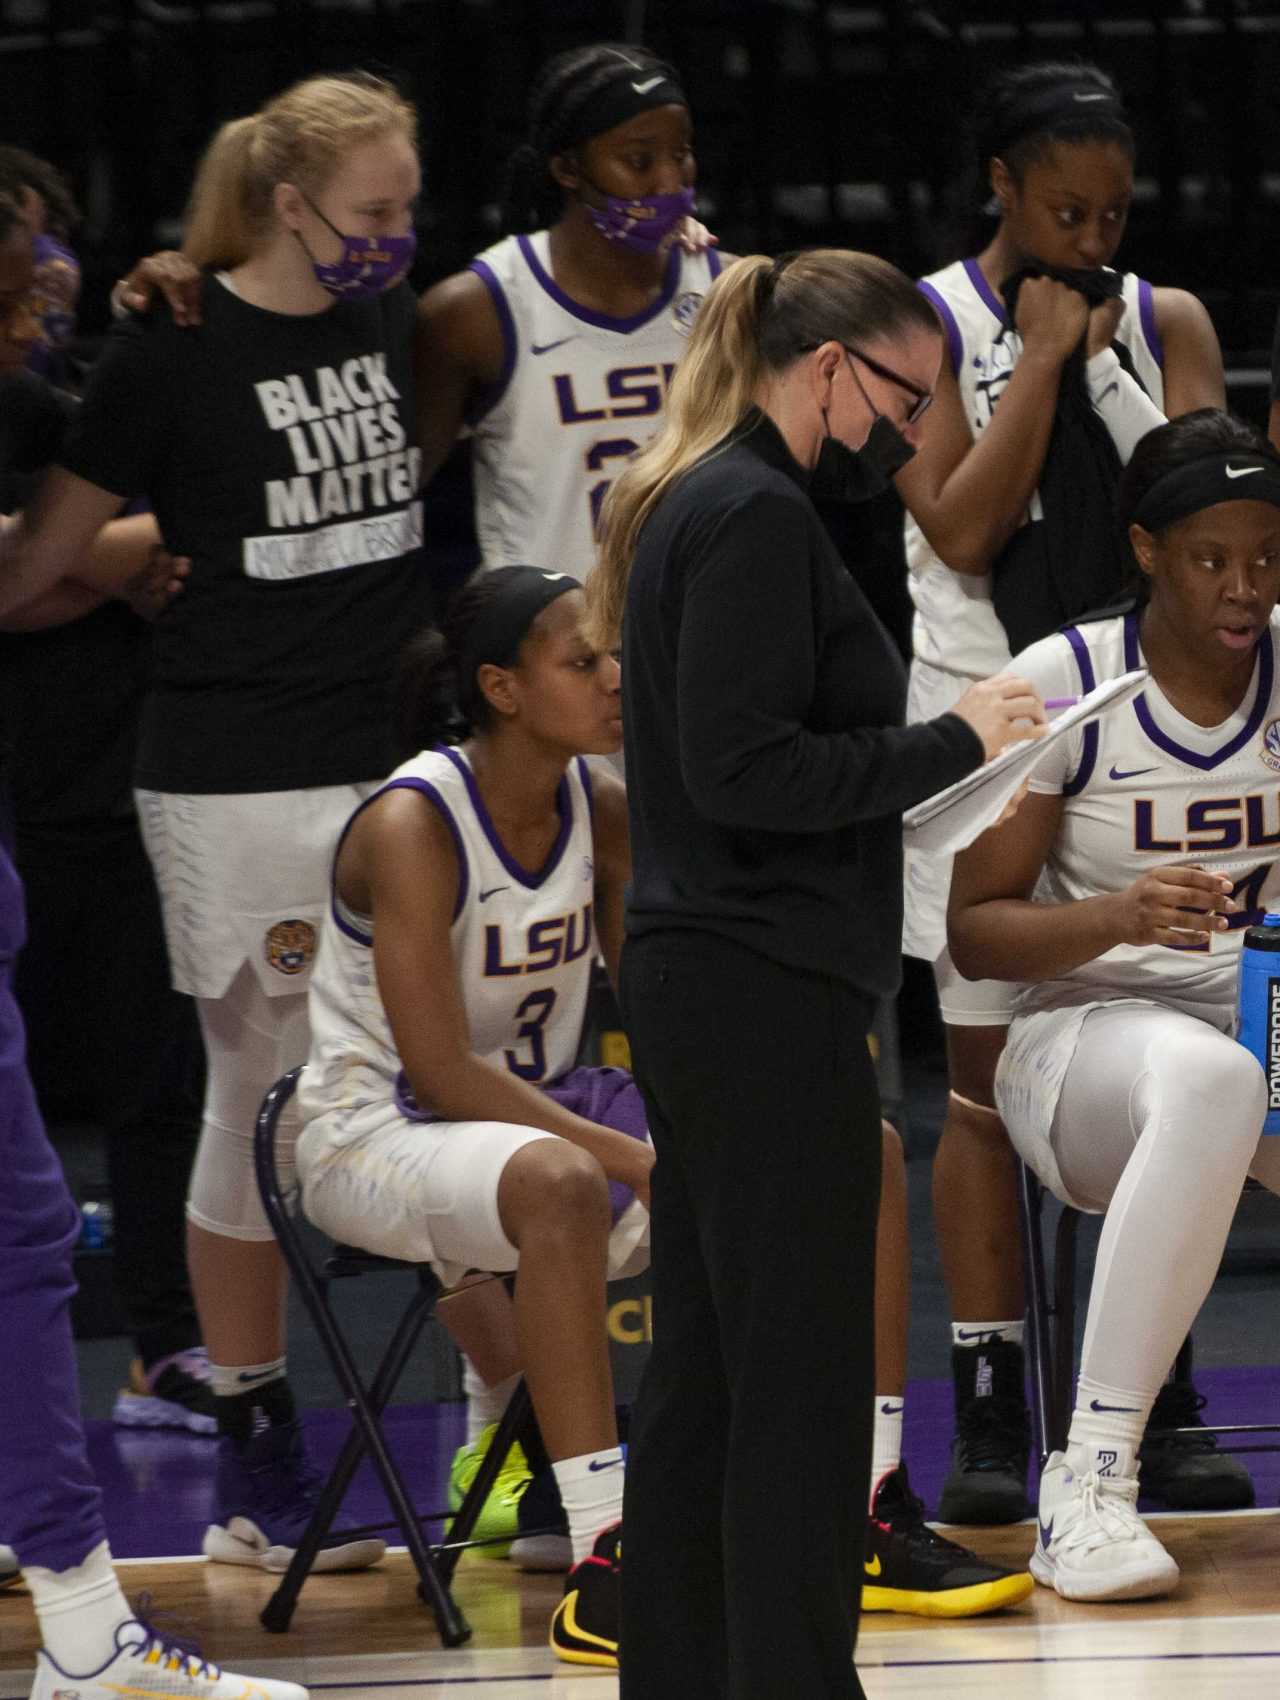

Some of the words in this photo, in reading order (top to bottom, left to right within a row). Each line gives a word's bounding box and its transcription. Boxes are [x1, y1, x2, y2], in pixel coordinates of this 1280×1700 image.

[253, 352, 402, 431] BLACK
[285, 403, 406, 475] LIVES
[480, 901, 593, 978] LSU
[505, 986, 558, 1083] 3
